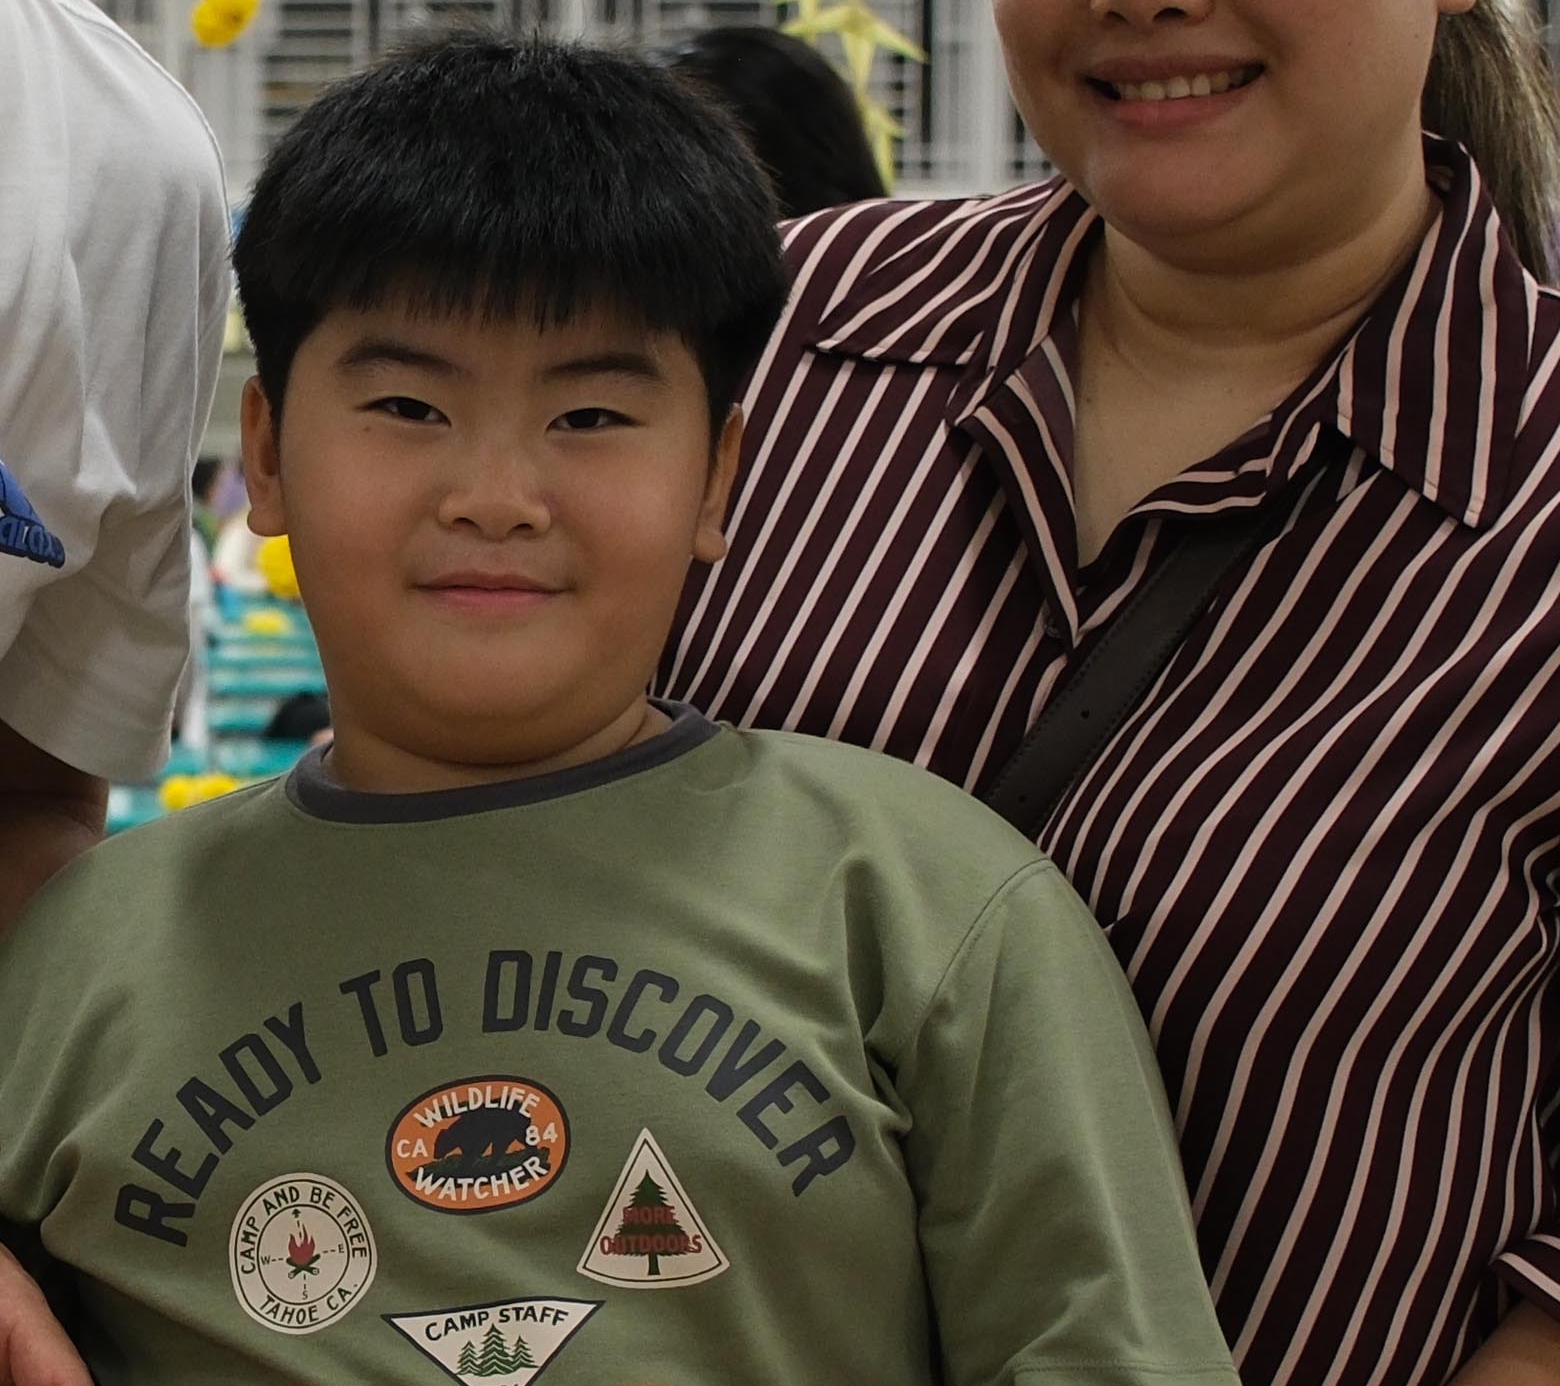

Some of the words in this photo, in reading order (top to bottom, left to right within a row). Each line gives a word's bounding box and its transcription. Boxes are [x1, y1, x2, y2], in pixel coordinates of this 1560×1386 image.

[114, 1001, 322, 1248] READY
[339, 957, 444, 1059] TO
[482, 949, 856, 1198] DISCOVER
[413, 1085, 541, 1129] WILDLIFE
[525, 1122, 559, 1147] 84
[396, 1138, 428, 1158] CA
[414, 1156, 549, 1202] WATCHER
[623, 1205, 676, 1224] MORE
[240, 1216, 260, 1275] CAMP
[262, 1186, 300, 1215] AND
[310, 1186, 336, 1209] BE
[336, 1205, 367, 1259] FREE
[338, 1244, 345, 1253] E
[599, 1234, 703, 1255] OUTDOORS
[260, 1255, 271, 1265] W
[302, 1291, 308, 1300] S
[259, 1295, 319, 1324] TAHOE
[425, 1310, 489, 1341] CAMP
[498, 1306, 569, 1326] STAFF
